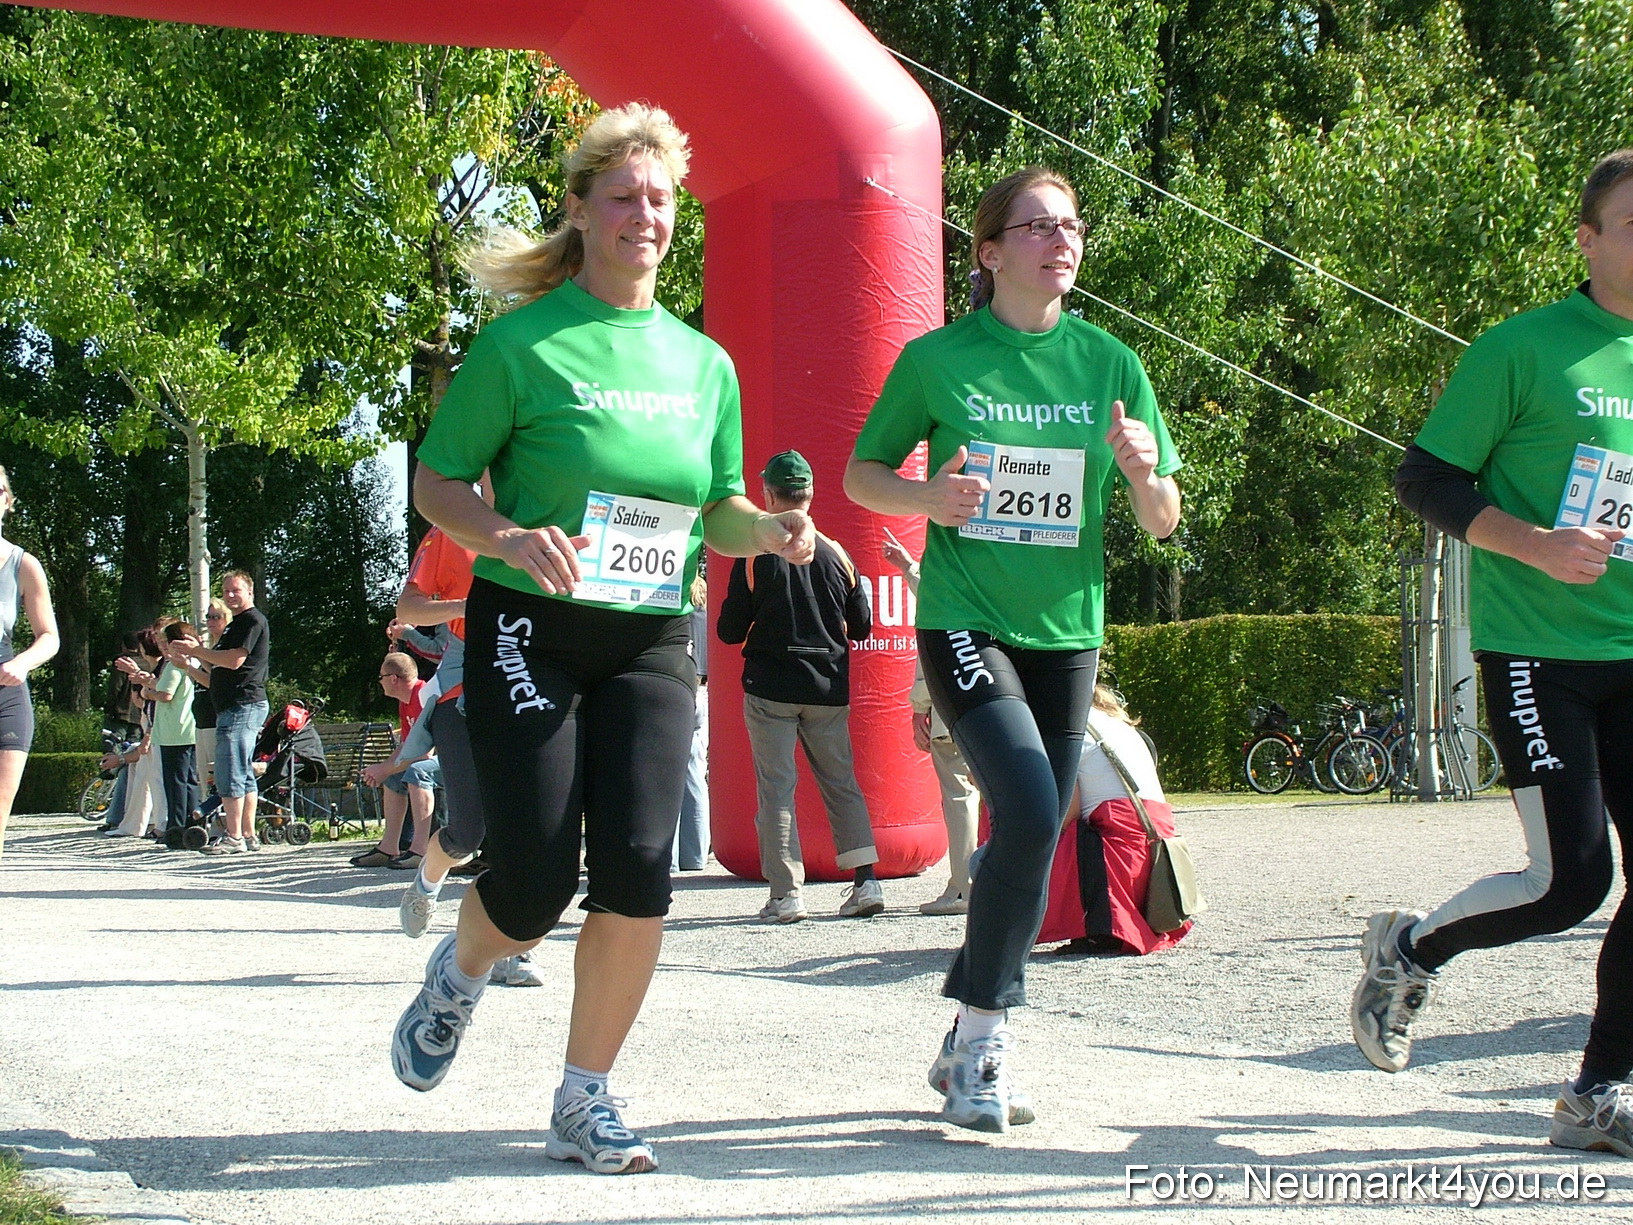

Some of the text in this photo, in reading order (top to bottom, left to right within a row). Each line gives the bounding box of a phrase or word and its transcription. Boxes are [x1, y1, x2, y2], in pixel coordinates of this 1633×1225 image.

[998, 455, 1051, 476] Renate
[1569, 483, 1579, 498] D
[995, 489, 1072, 519] 2618
[613, 505, 660, 529] Sabine
[960, 524, 1005, 536] BOCK
[1033, 529, 1077, 541] PFLEIDERER
[609, 543, 676, 577] 2606
[893, 635, 907, 651] ist
[946, 630, 994, 691] Sinu
